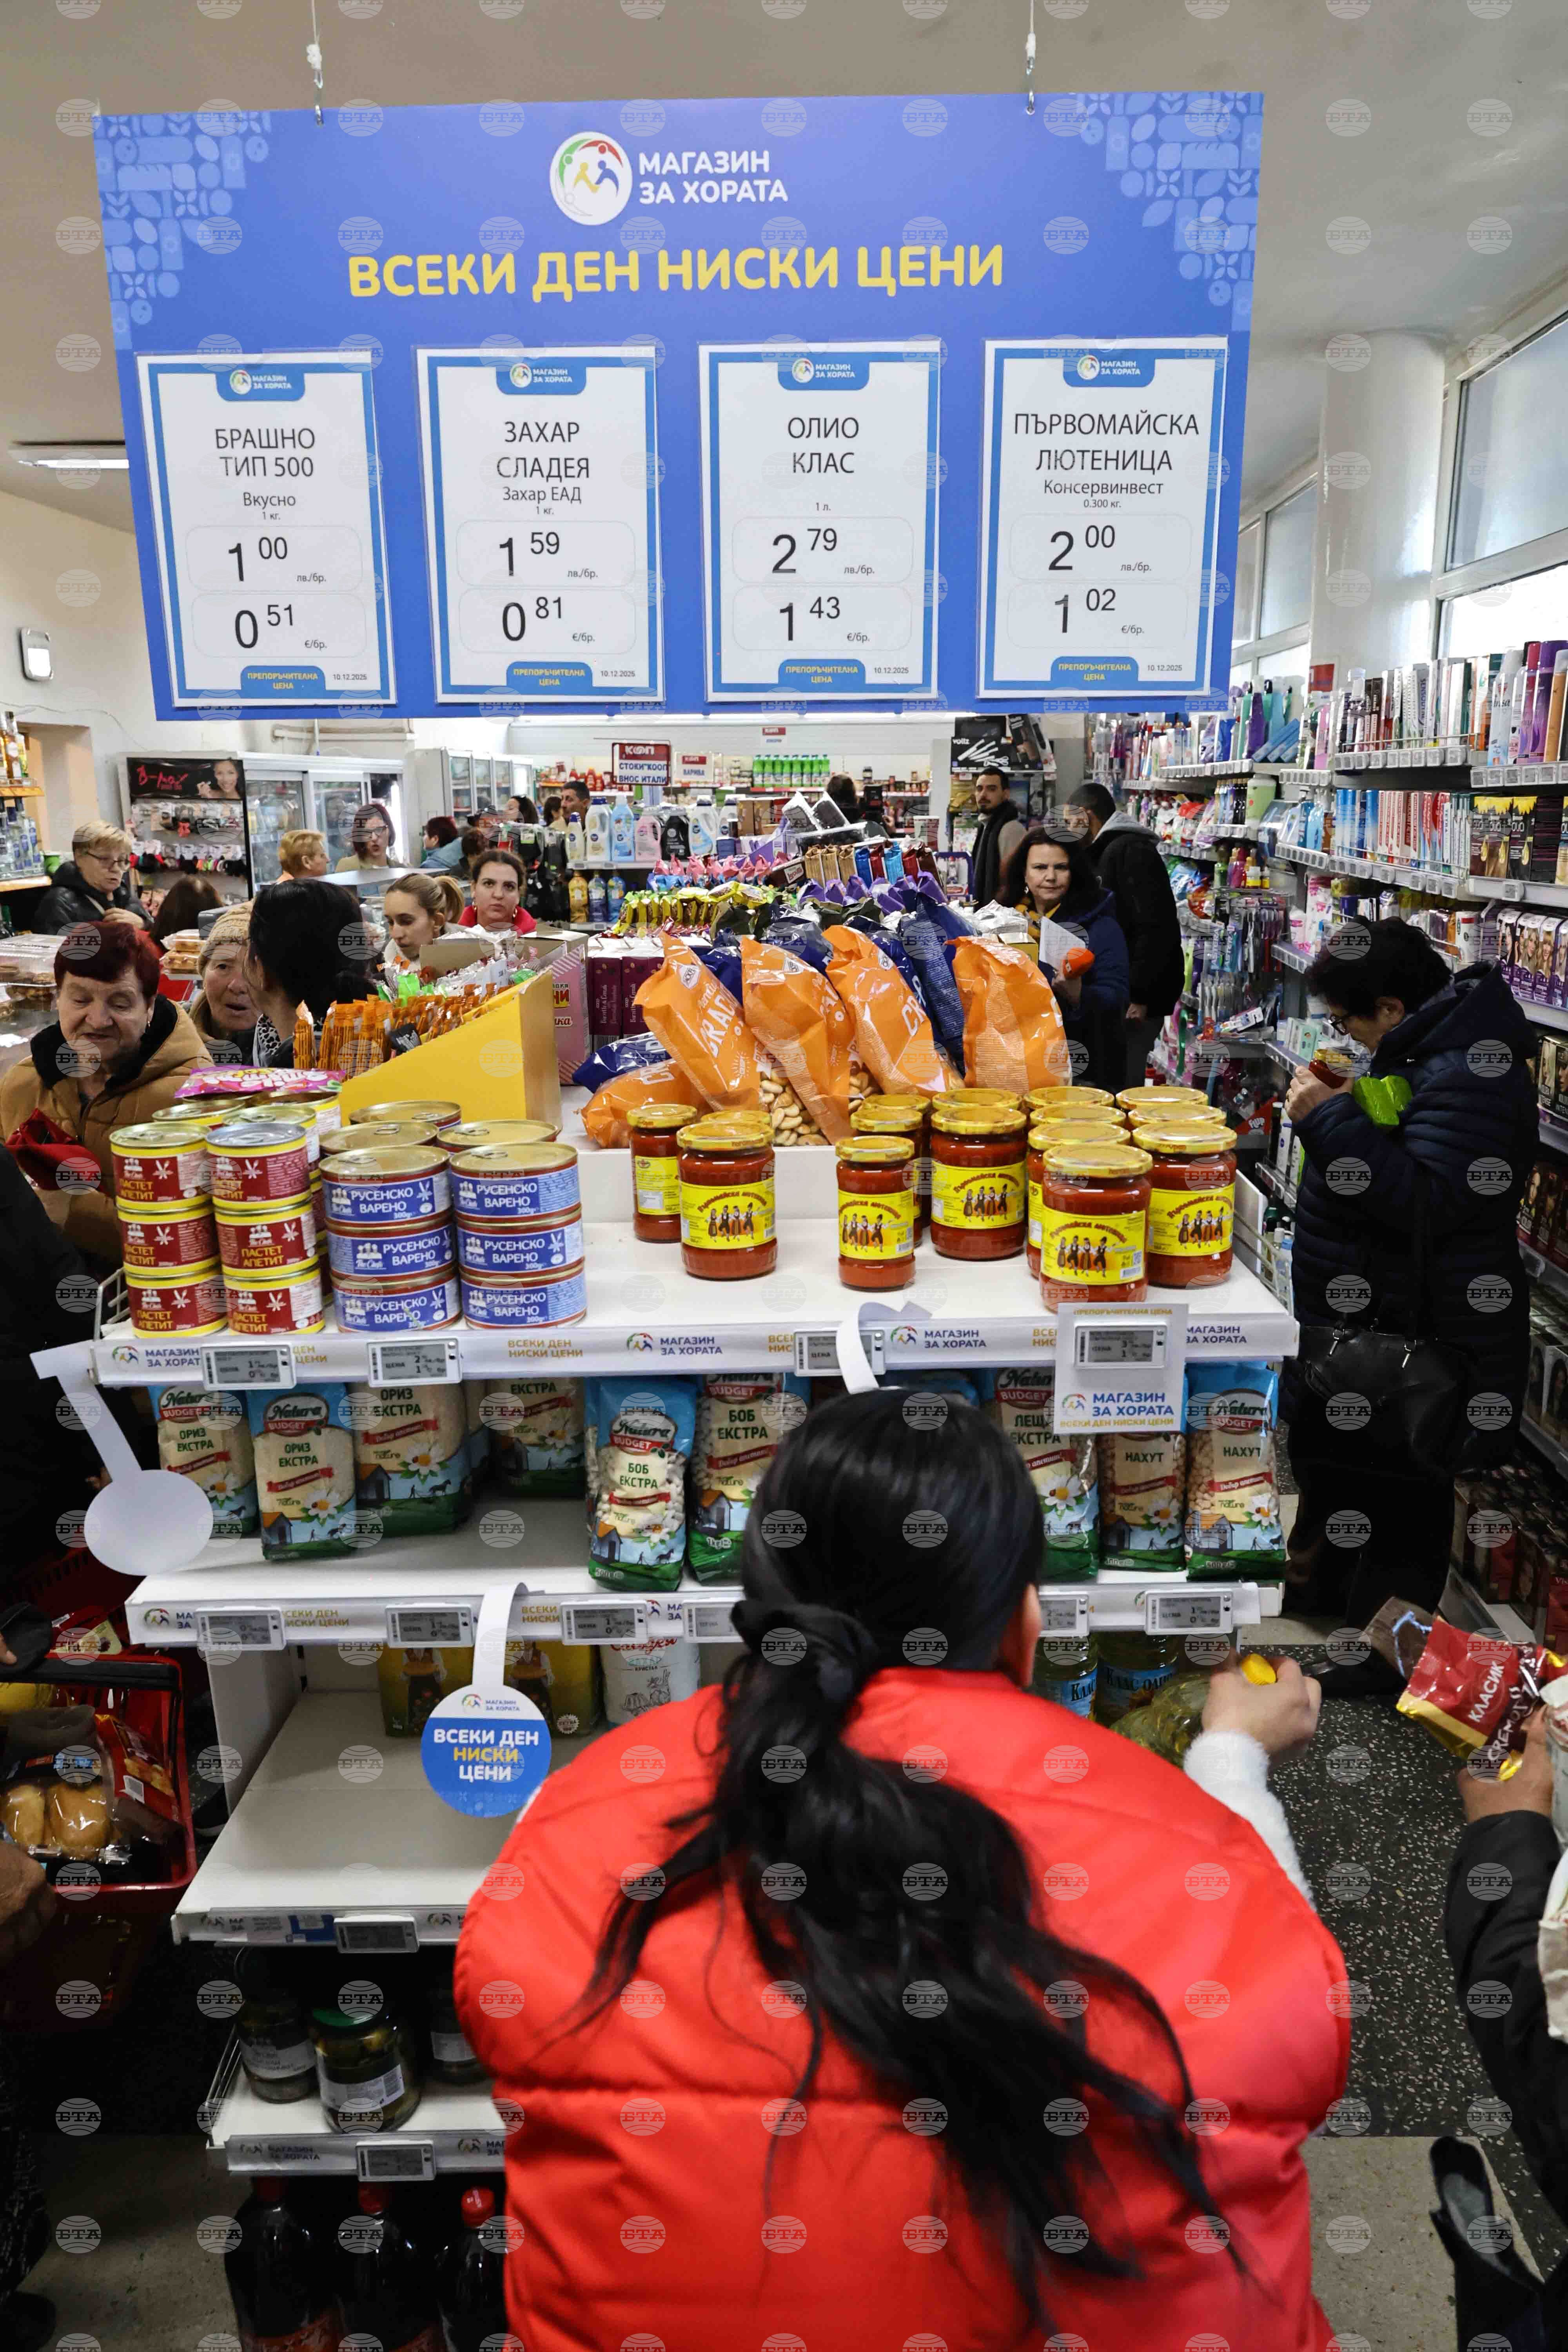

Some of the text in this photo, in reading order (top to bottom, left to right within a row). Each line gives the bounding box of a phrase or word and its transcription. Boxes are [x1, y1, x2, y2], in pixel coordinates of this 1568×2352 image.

[639, 151, 770, 175] МАГАЗИН
[639, 180, 788, 205] ЗА ХОРАТА
[348, 244, 1004, 303] ВСЕКИ ДЕН НИСКИ ЦЕНИ
[787, 417, 859, 439] ОЛИО
[1014, 410, 1198, 435] ПЪРВОМАЙСКА
[505, 422, 579, 442] ЗАХАР
[216, 428, 315, 450] БРАШНО
[220, 456, 314, 477] ТИП 500
[793, 452, 855, 474] КЛАС
[1036, 449, 1173, 475] ЛЮТЕНИЦА
[497, 457, 590, 481] СЛАДЕЯ
[1044, 480, 1163, 497] Консервинвест
[243, 492, 296, 509] Вкусно
[503, 486, 582, 505] Захар ЕАД
[543, 508, 554, 516] кг.
[1111, 501, 1121, 510] кг.
[270, 513, 280, 521] кг.
[499, 538, 514, 576] 1
[530, 532, 560, 555] 59
[772, 534, 797, 574] 2
[807, 528, 837, 551] 79
[1048, 532, 1074, 571] 2
[1085, 525, 1115, 548] 00
[229, 543, 244, 581] 1
[258, 537, 288, 559] 00
[1054, 589, 1145, 635] 1 02 €/бр.
[503, 597, 595, 643] 0 81 €/бр.
[779, 597, 869, 643] 1 43 €/бр.
[235, 605, 327, 650] 0 51 €/бр.
[514, 669, 585, 678] ПРЕПОРЪЧИТЕЛНА
[785, 666, 858, 675] ПРЕПОРЪЧИТЕЛНА
[1059, 663, 1131, 672] ПРЕПОРЪЧИТЕЛНА
[247, 672, 318, 681] ПРЕПОРЪЧИТЕЛНА
[539, 679, 560, 687] ЦЕНА
[811, 675, 832, 684] ЦЕНА
[383, 1236, 441, 1254] РУСЕНСКО
[485, 1237, 545, 1250] РУСЕНСКО
[241, 1246, 283, 1258] ПАСТЕТ
[392, 1250, 436, 1266] ВАРЕНО
[492, 1251, 538, 1263] ВАРЕНО
[243, 1255, 284, 1267] АПЕТИТ
[924, 1329, 979, 1339] МАГАЗИН
[1186, 1326, 1240, 1335] МАГАЗИН
[508, 1339, 572, 1348] ВСЕКИ ДЕН
[660, 1336, 715, 1345] МАГАЗИН
[925, 1339, 986, 1348] ЗА ХОРАТА
[1186, 1335, 1247, 1344] ЗА ХОРАТА
[145, 1348, 200, 1358] МАГАЗИН
[509, 1349, 583, 1359] НИСКИ ЦЕНИ
[661, 1345, 723, 1355] ЗА ХОРАТА
[147, 1357, 200, 1368] ЗА ХОРАТ
[380, 1388, 414, 1401] ОРИЗ
[709, 1386, 755, 1397] BUDGET
[1000, 1391, 1042, 1401] BUDGET
[1092, 1392, 1165, 1403] МАГАЗИН
[374, 1403, 421, 1417] ЕКСТРА
[729, 1409, 756, 1423] БОБ
[1092, 1405, 1174, 1416] ЗА ХОРАТА
[268, 1421, 305, 1431] BUDGET
[1014, 1414, 1053, 1429] ЛЕЩ
[1092, 1419, 1111, 1428] ДЕН
[1113, 1418, 1145, 1426] НИСКИ
[1148, 1418, 1174, 1427] ЦЕНИ
[717, 1426, 768, 1439] ЕКСТРА
[285, 1442, 310, 1454] ОРИЗ
[1223, 1446, 1262, 1459] НАХУТ
[278, 1455, 318, 1468] ЕКСТРА
[1125, 1452, 1165, 1463] НАХУТ
[628, 1463, 649, 1475] БОБ
[619, 1475, 659, 1489] ЕКСТРА
[282, 1609, 339, 1619] СЕКИ ДЕН
[318, 1618, 349, 1628] ЦЕНИ
[1467, 1661, 1506, 1724] КЛАСИК
[433, 1728, 539, 1748] ВСЕКИ ДЕН
[453, 1746, 519, 1762] НИСКИ
[459, 1765, 512, 1783] ЦЕНИ
